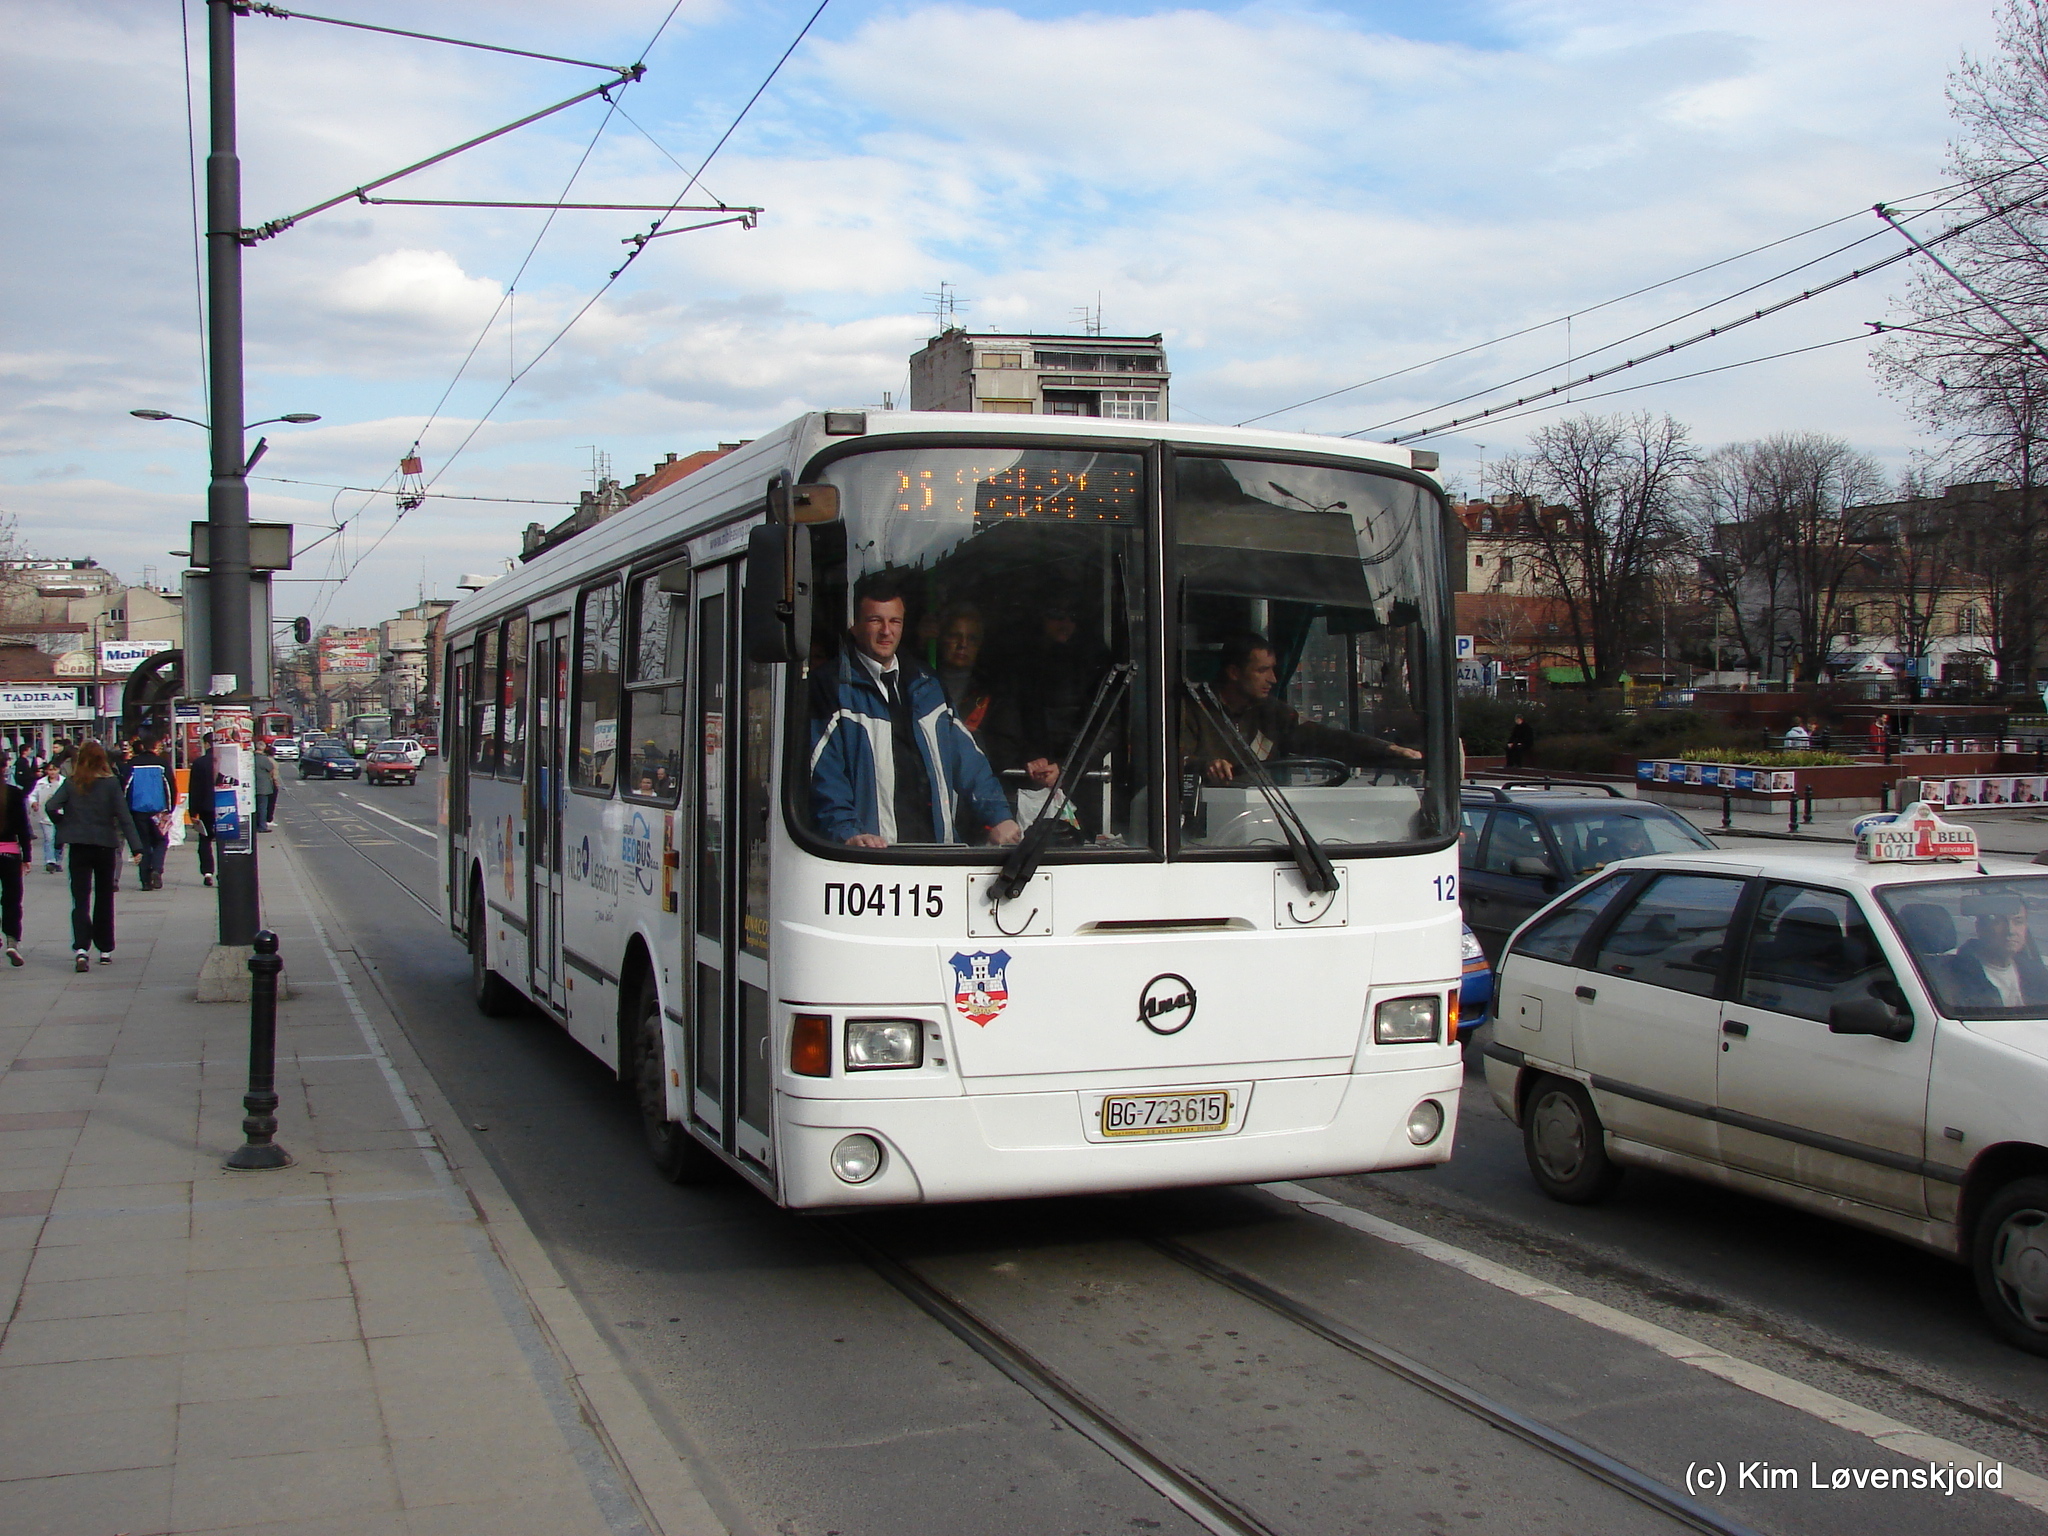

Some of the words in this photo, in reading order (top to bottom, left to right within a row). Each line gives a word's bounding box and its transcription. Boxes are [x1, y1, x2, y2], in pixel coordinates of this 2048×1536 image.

[1458, 639, 1470, 655] P
[3, 692, 75, 702] TADIRAN
[1875, 832, 1913, 843] TAXI
[1939, 831, 1974, 843] BELL
[568, 844, 581, 882] NLB
[622, 836, 652, 868] BEOBUS
[591, 853, 619, 908] Leasing
[1433, 874, 1455, 901] 12
